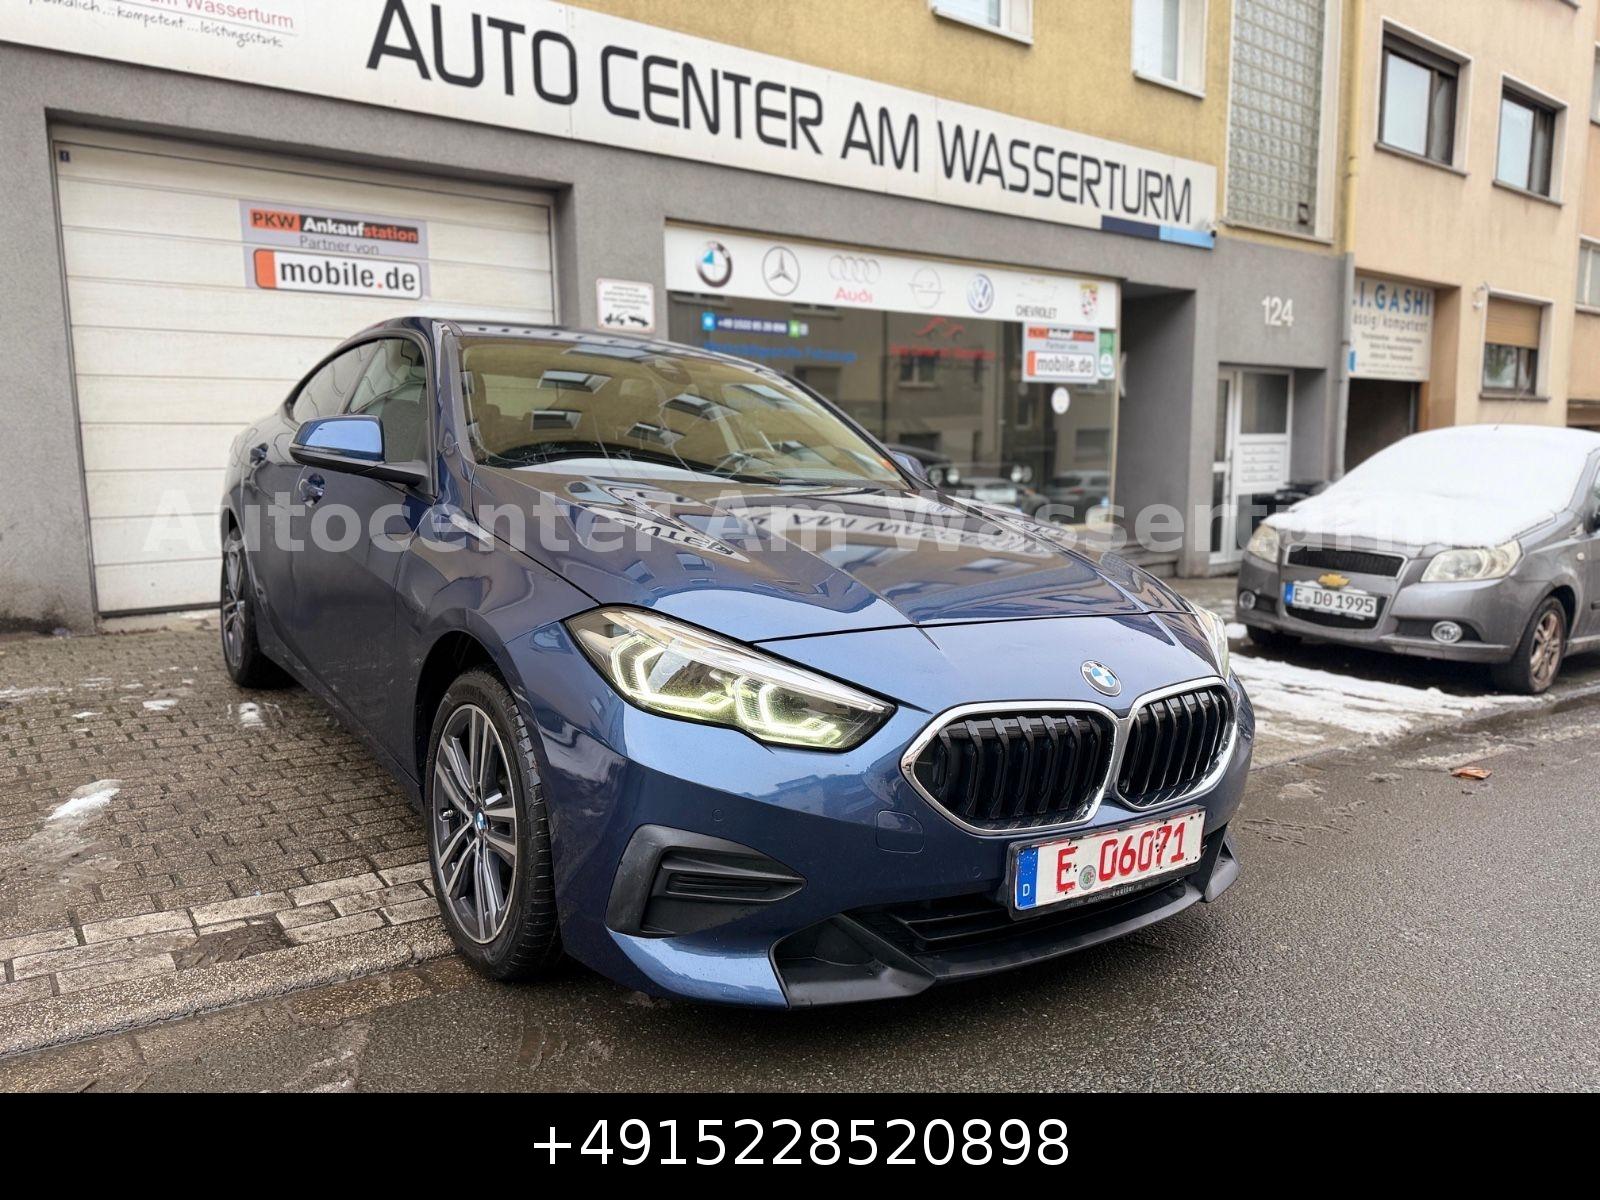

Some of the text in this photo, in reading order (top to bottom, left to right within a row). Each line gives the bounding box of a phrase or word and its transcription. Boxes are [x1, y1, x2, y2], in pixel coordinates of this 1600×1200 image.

[186, 0, 294, 28] Wasserturm
[366, 0, 1191, 225] AUTO CENTER AM WASSERTURM
[252, 211, 418, 242] PKW Ankaufstation
[300, 235, 379, 255] Partner von
[280, 261, 416, 291] mobile.de
[835, 287, 874, 304] Audi
[1016, 305, 1058, 319] CHEVROLET
[1261, 296, 1295, 327] 124
[1037, 355, 1093, 374] mobile.de
[1294, 588, 1303, 603] E
[1337, 595, 1375, 614] 1995
[1056, 821, 1186, 894] E 06071
[1022, 883, 1031, 897] D
